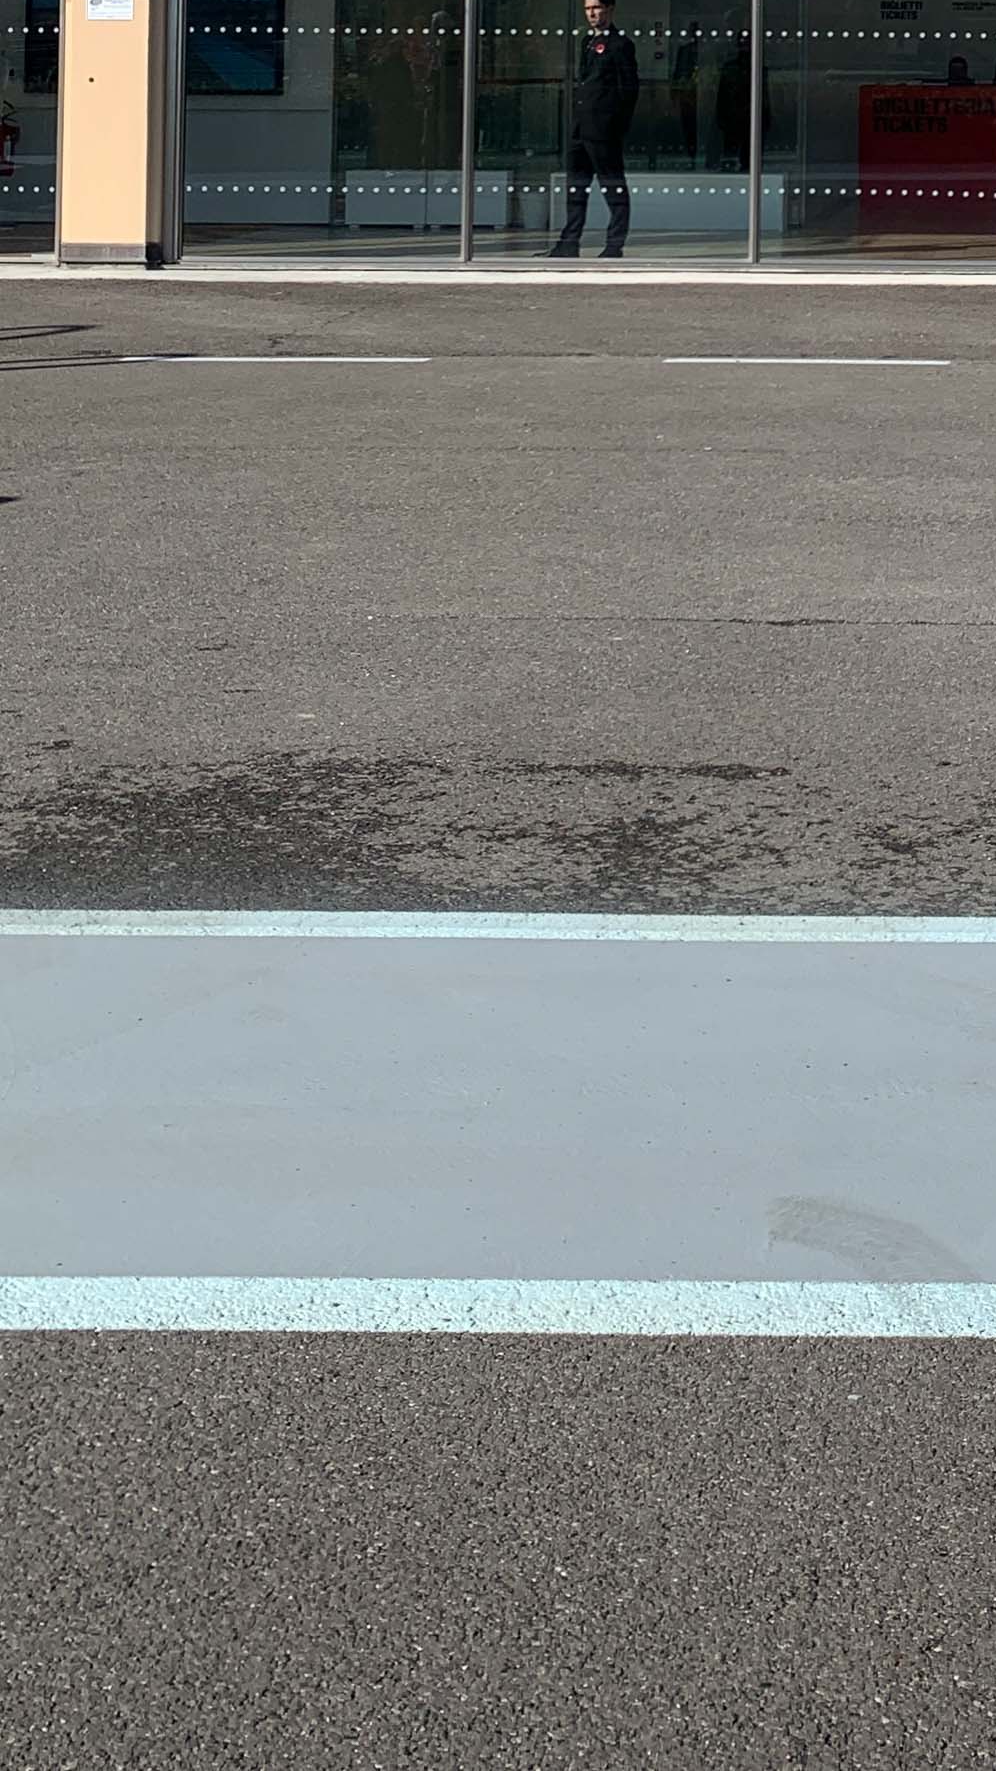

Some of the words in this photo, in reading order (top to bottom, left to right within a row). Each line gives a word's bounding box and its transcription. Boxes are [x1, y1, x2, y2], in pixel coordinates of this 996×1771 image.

[880, 1, 923, 10] BIGLIETTI
[880, 11, 918, 20] TICKETS
[873, 116, 948, 133] TICKETS
